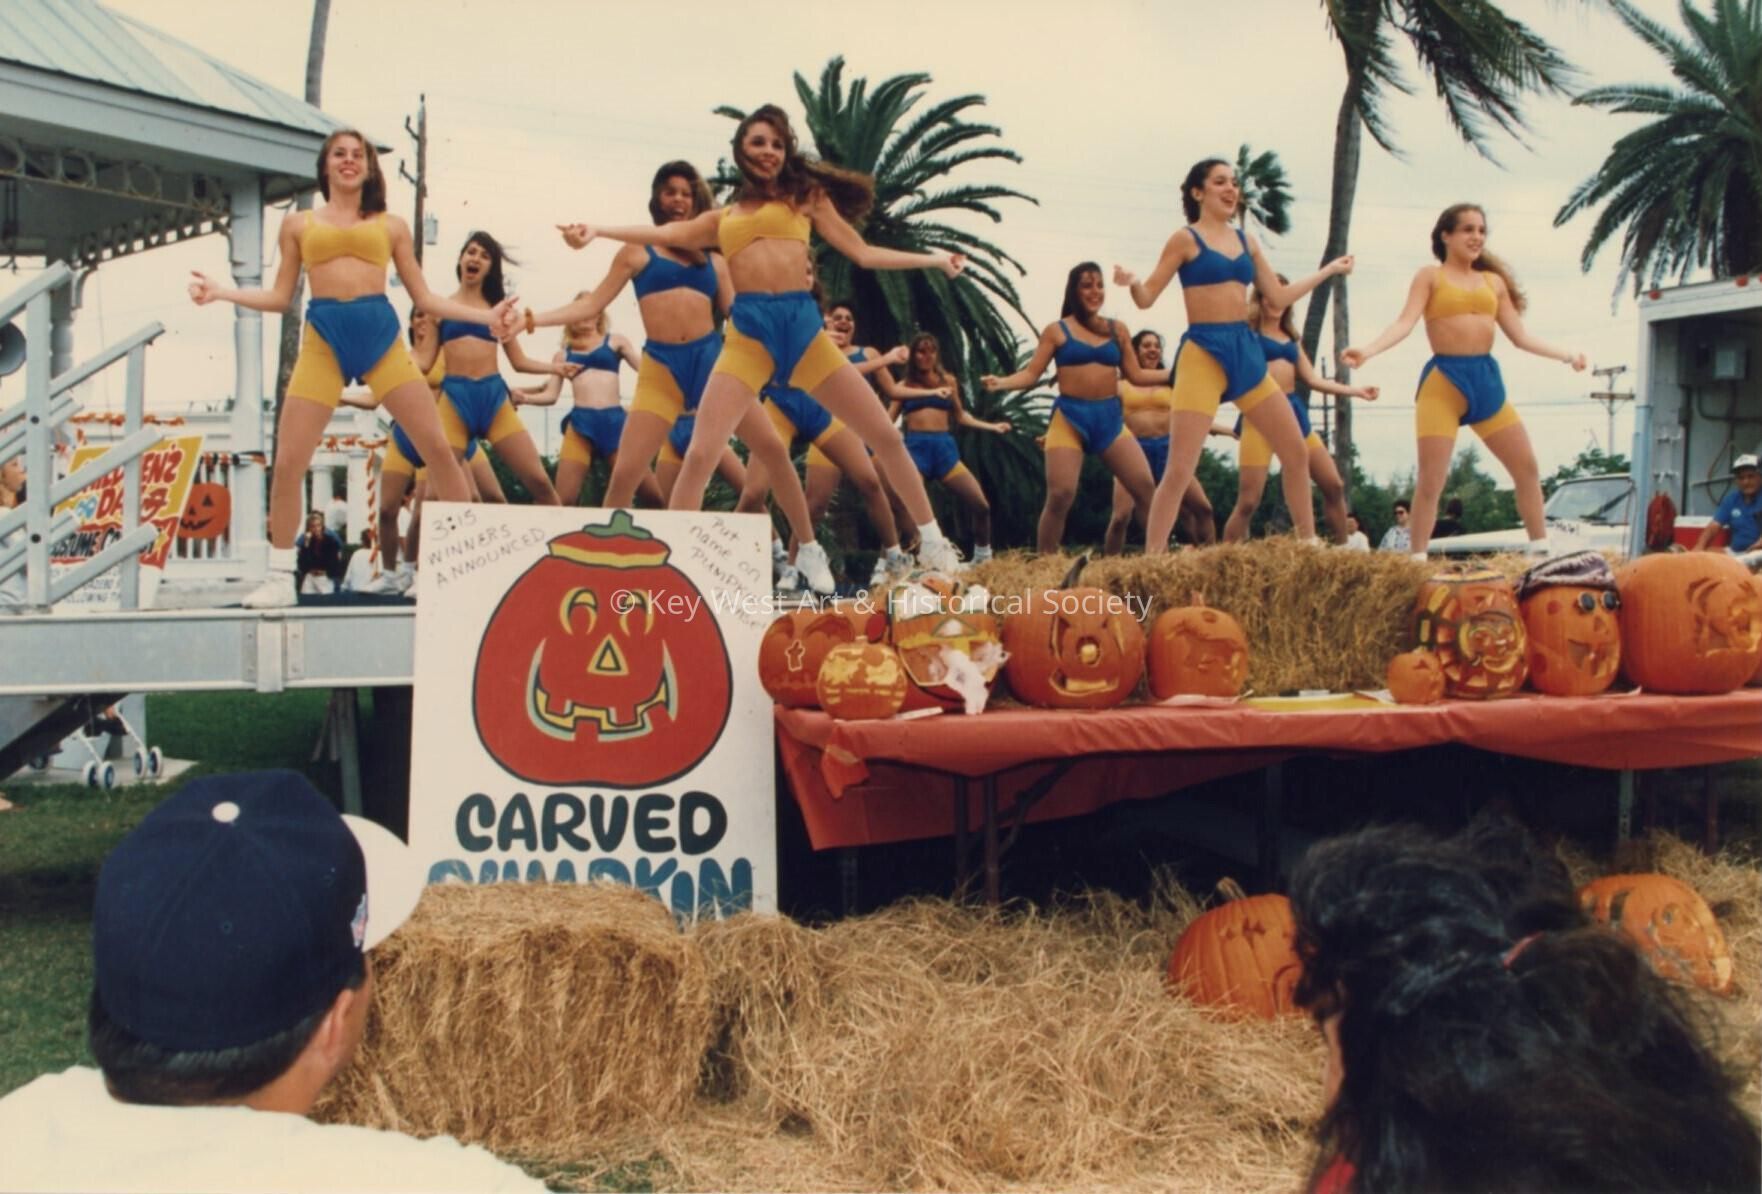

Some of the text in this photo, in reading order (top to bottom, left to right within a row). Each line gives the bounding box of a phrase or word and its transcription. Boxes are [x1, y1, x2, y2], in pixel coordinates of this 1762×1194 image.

[428, 523, 512, 566] WINNERS
[430, 509, 477, 541] 3:15
[689, 525, 761, 583] name on
[436, 527, 545, 589] ANNOUNCED
[456, 790, 728, 855] CARVED
